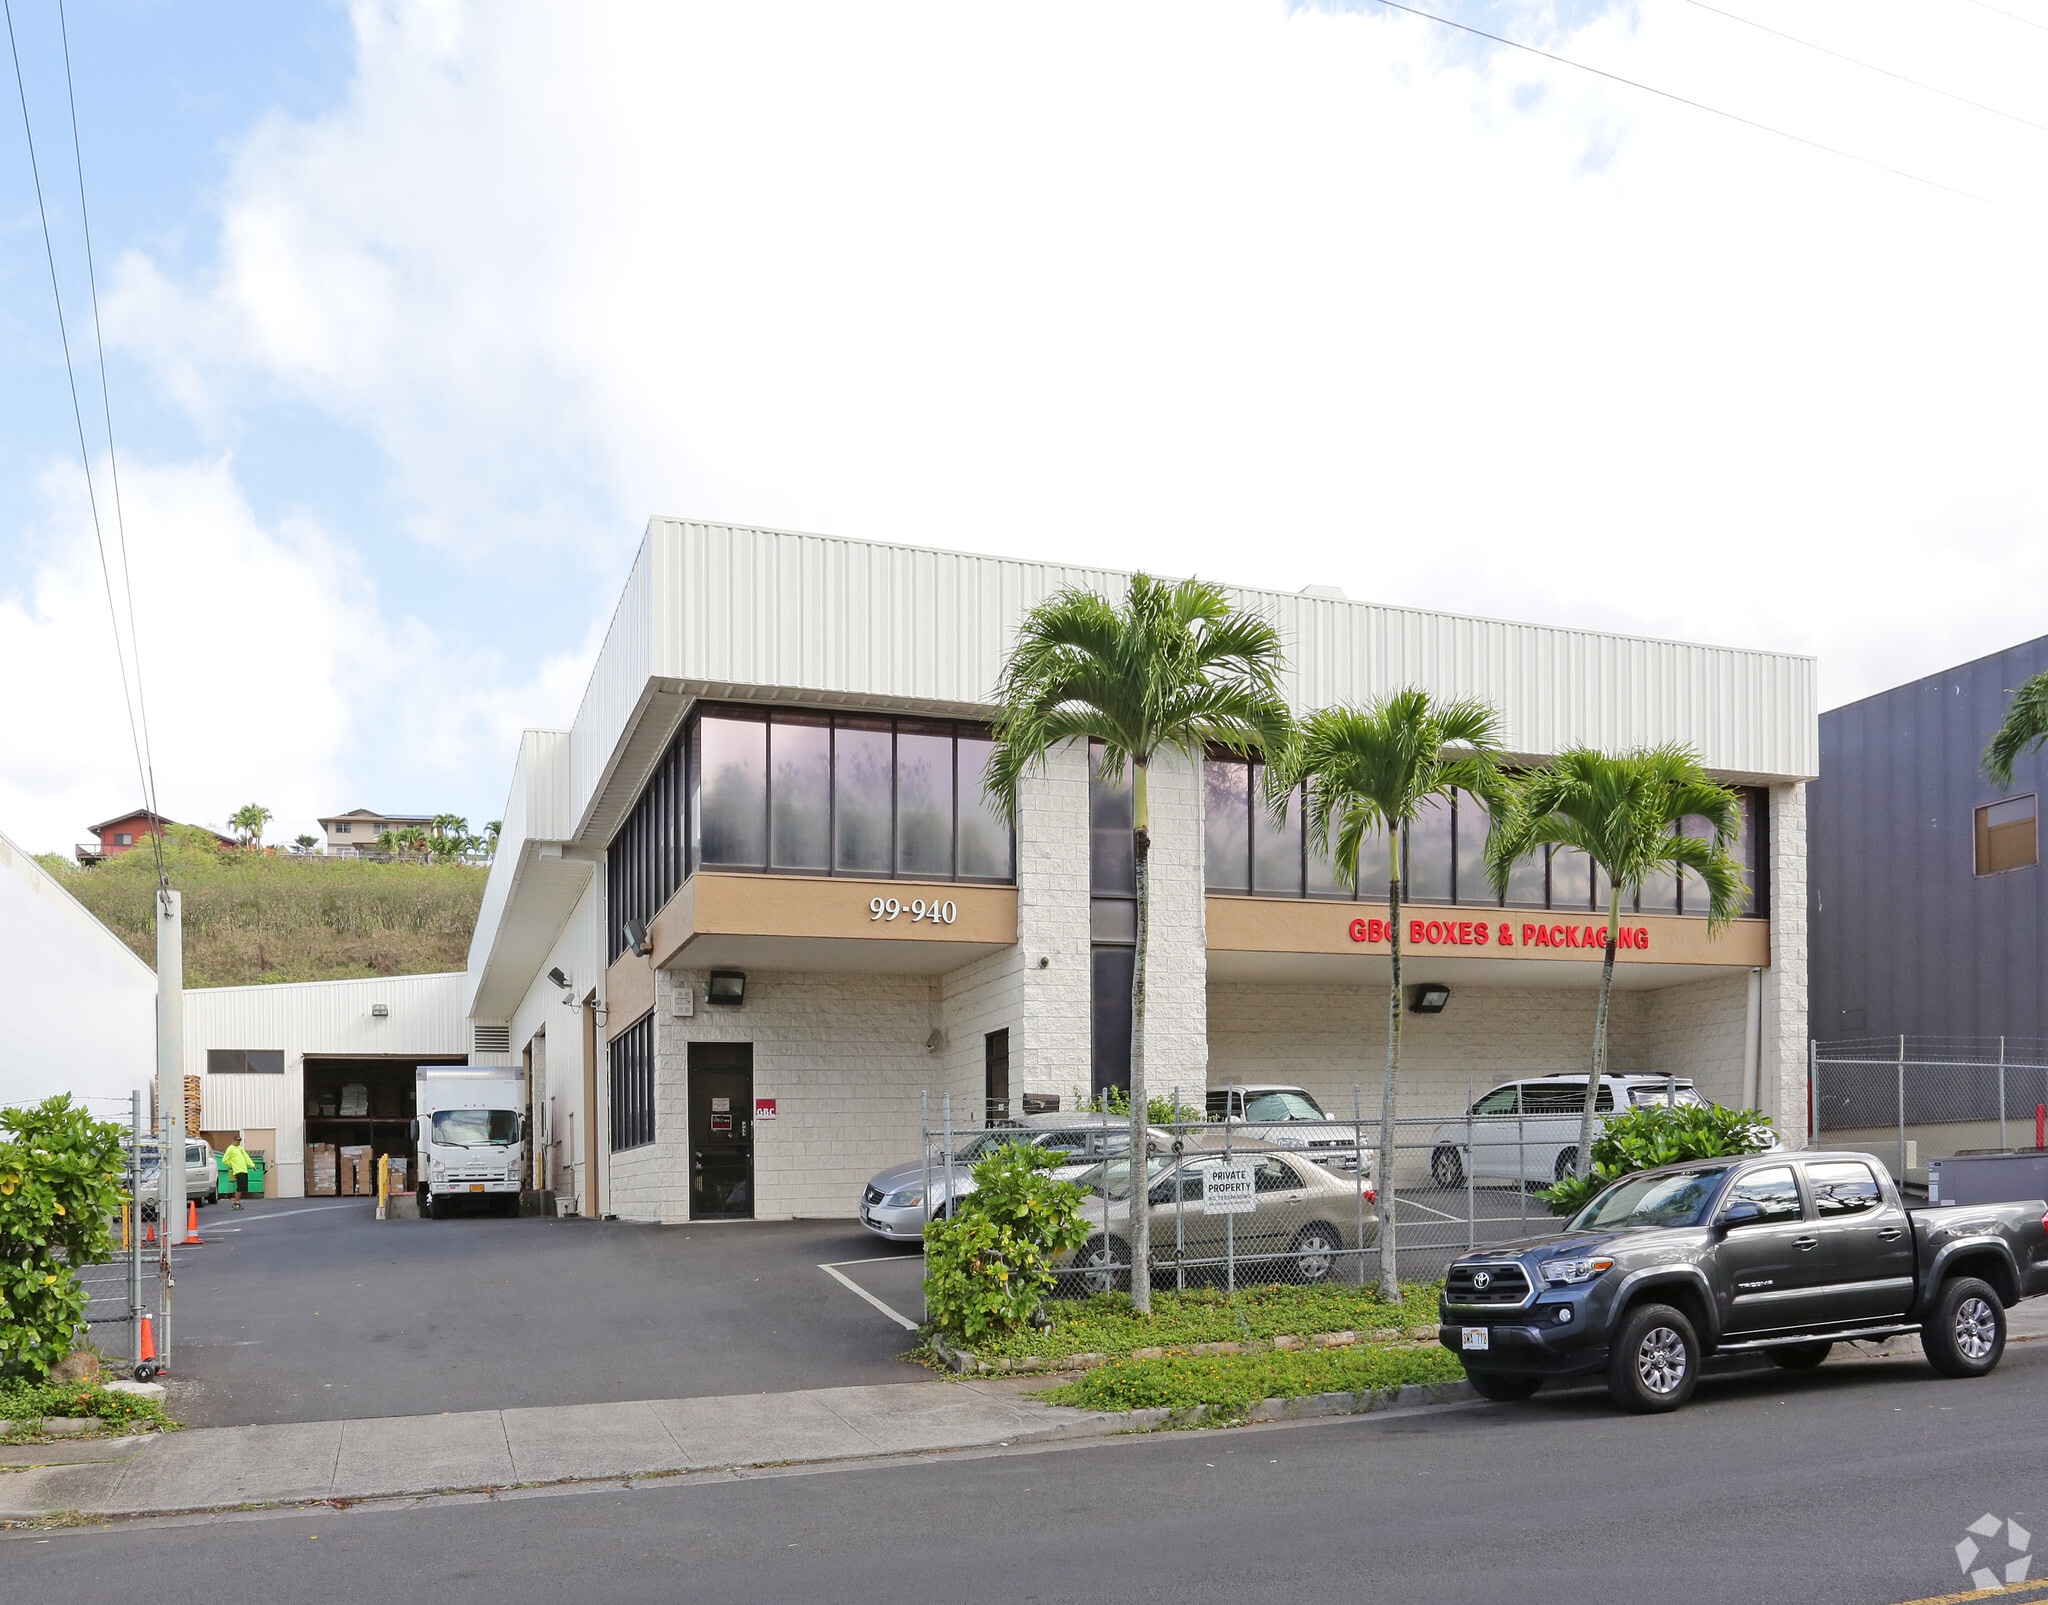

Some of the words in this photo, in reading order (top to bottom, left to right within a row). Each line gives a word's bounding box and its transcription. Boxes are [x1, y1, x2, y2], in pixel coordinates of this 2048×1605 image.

[869, 897, 957, 924] 99-940
[1410, 920, 1489, 945] BOXES
[1499, 923, 1514, 946] &
[1523, 924, 1649, 949] PACKAGNG
[757, 1108, 775, 1117] GBC
[1212, 1171, 1246, 1180] PRIVATE
[1208, 1182, 1251, 1192] PROPERTY
